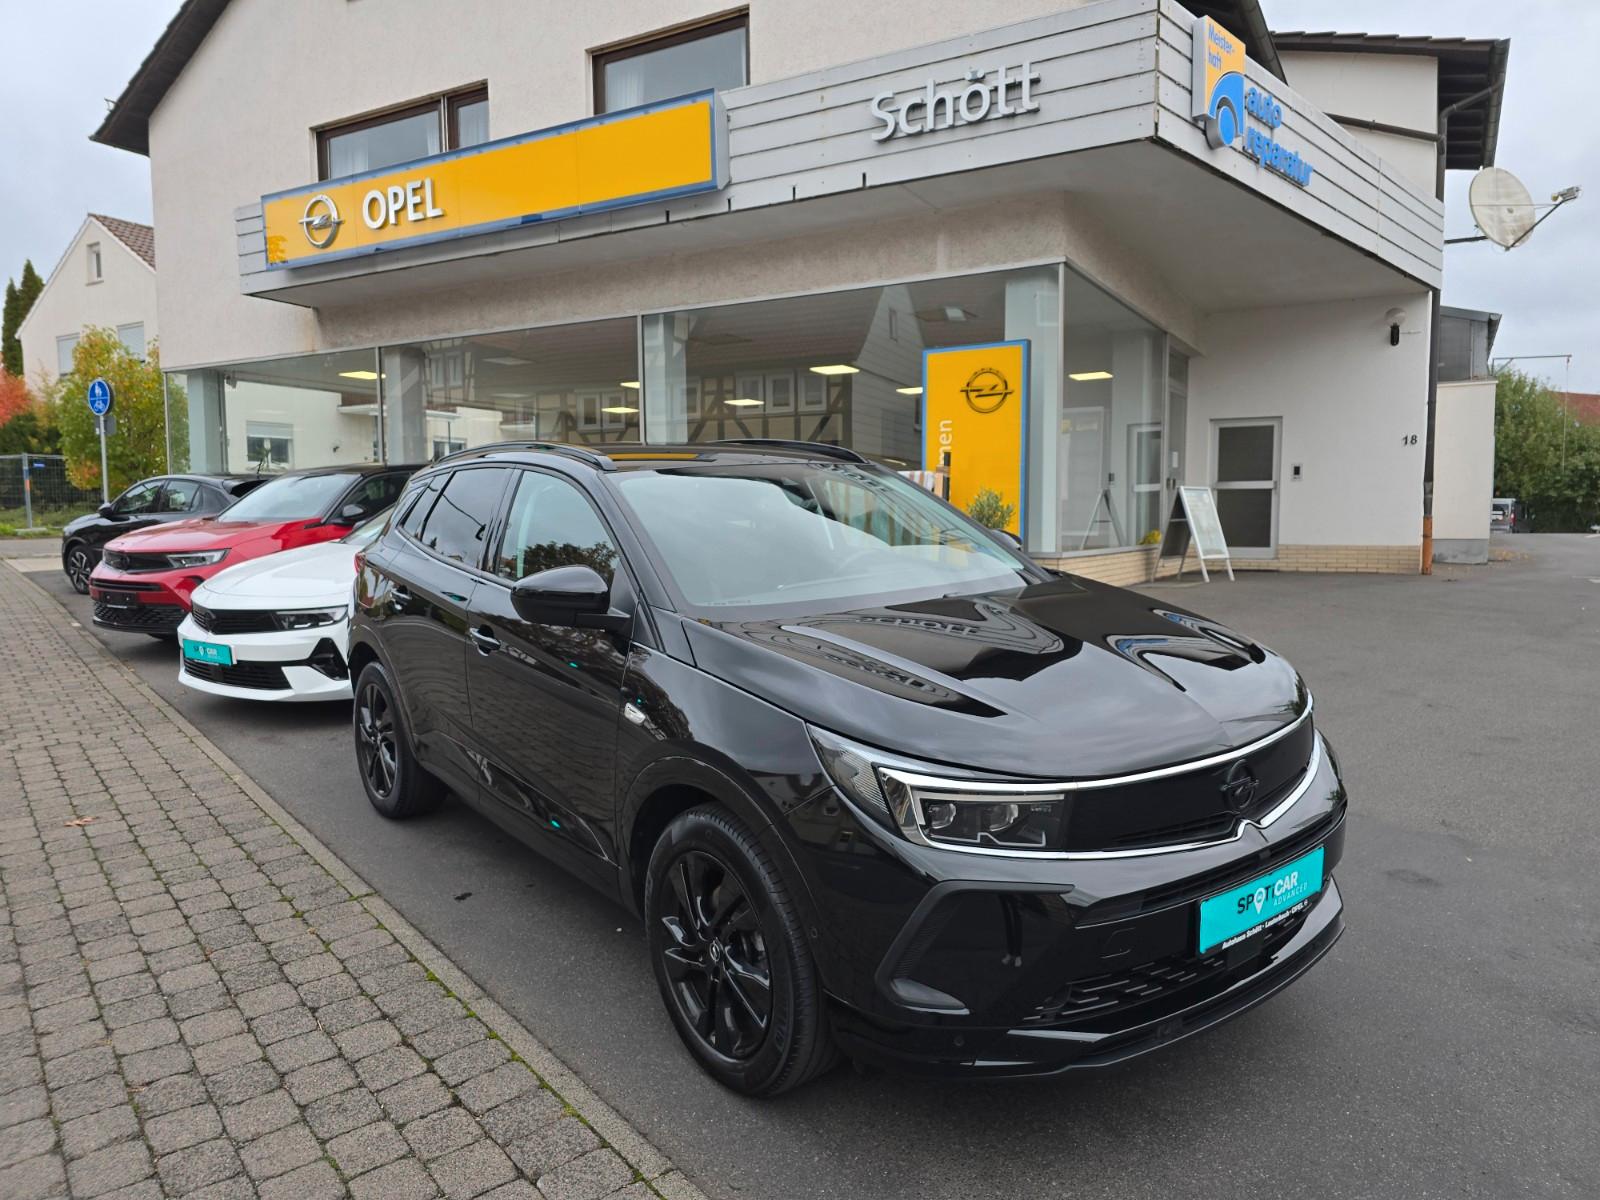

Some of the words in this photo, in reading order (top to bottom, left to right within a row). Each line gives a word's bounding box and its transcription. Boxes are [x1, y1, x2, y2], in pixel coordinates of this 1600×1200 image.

[871, 60, 1041, 142] Schött
[1246, 87, 1282, 128] auto
[1246, 126, 1313, 187] reparatur
[362, 177, 444, 230] OPEL
[1402, 434, 1418, 446] 18
[1273, 881, 1308, 906] ADVANCED
